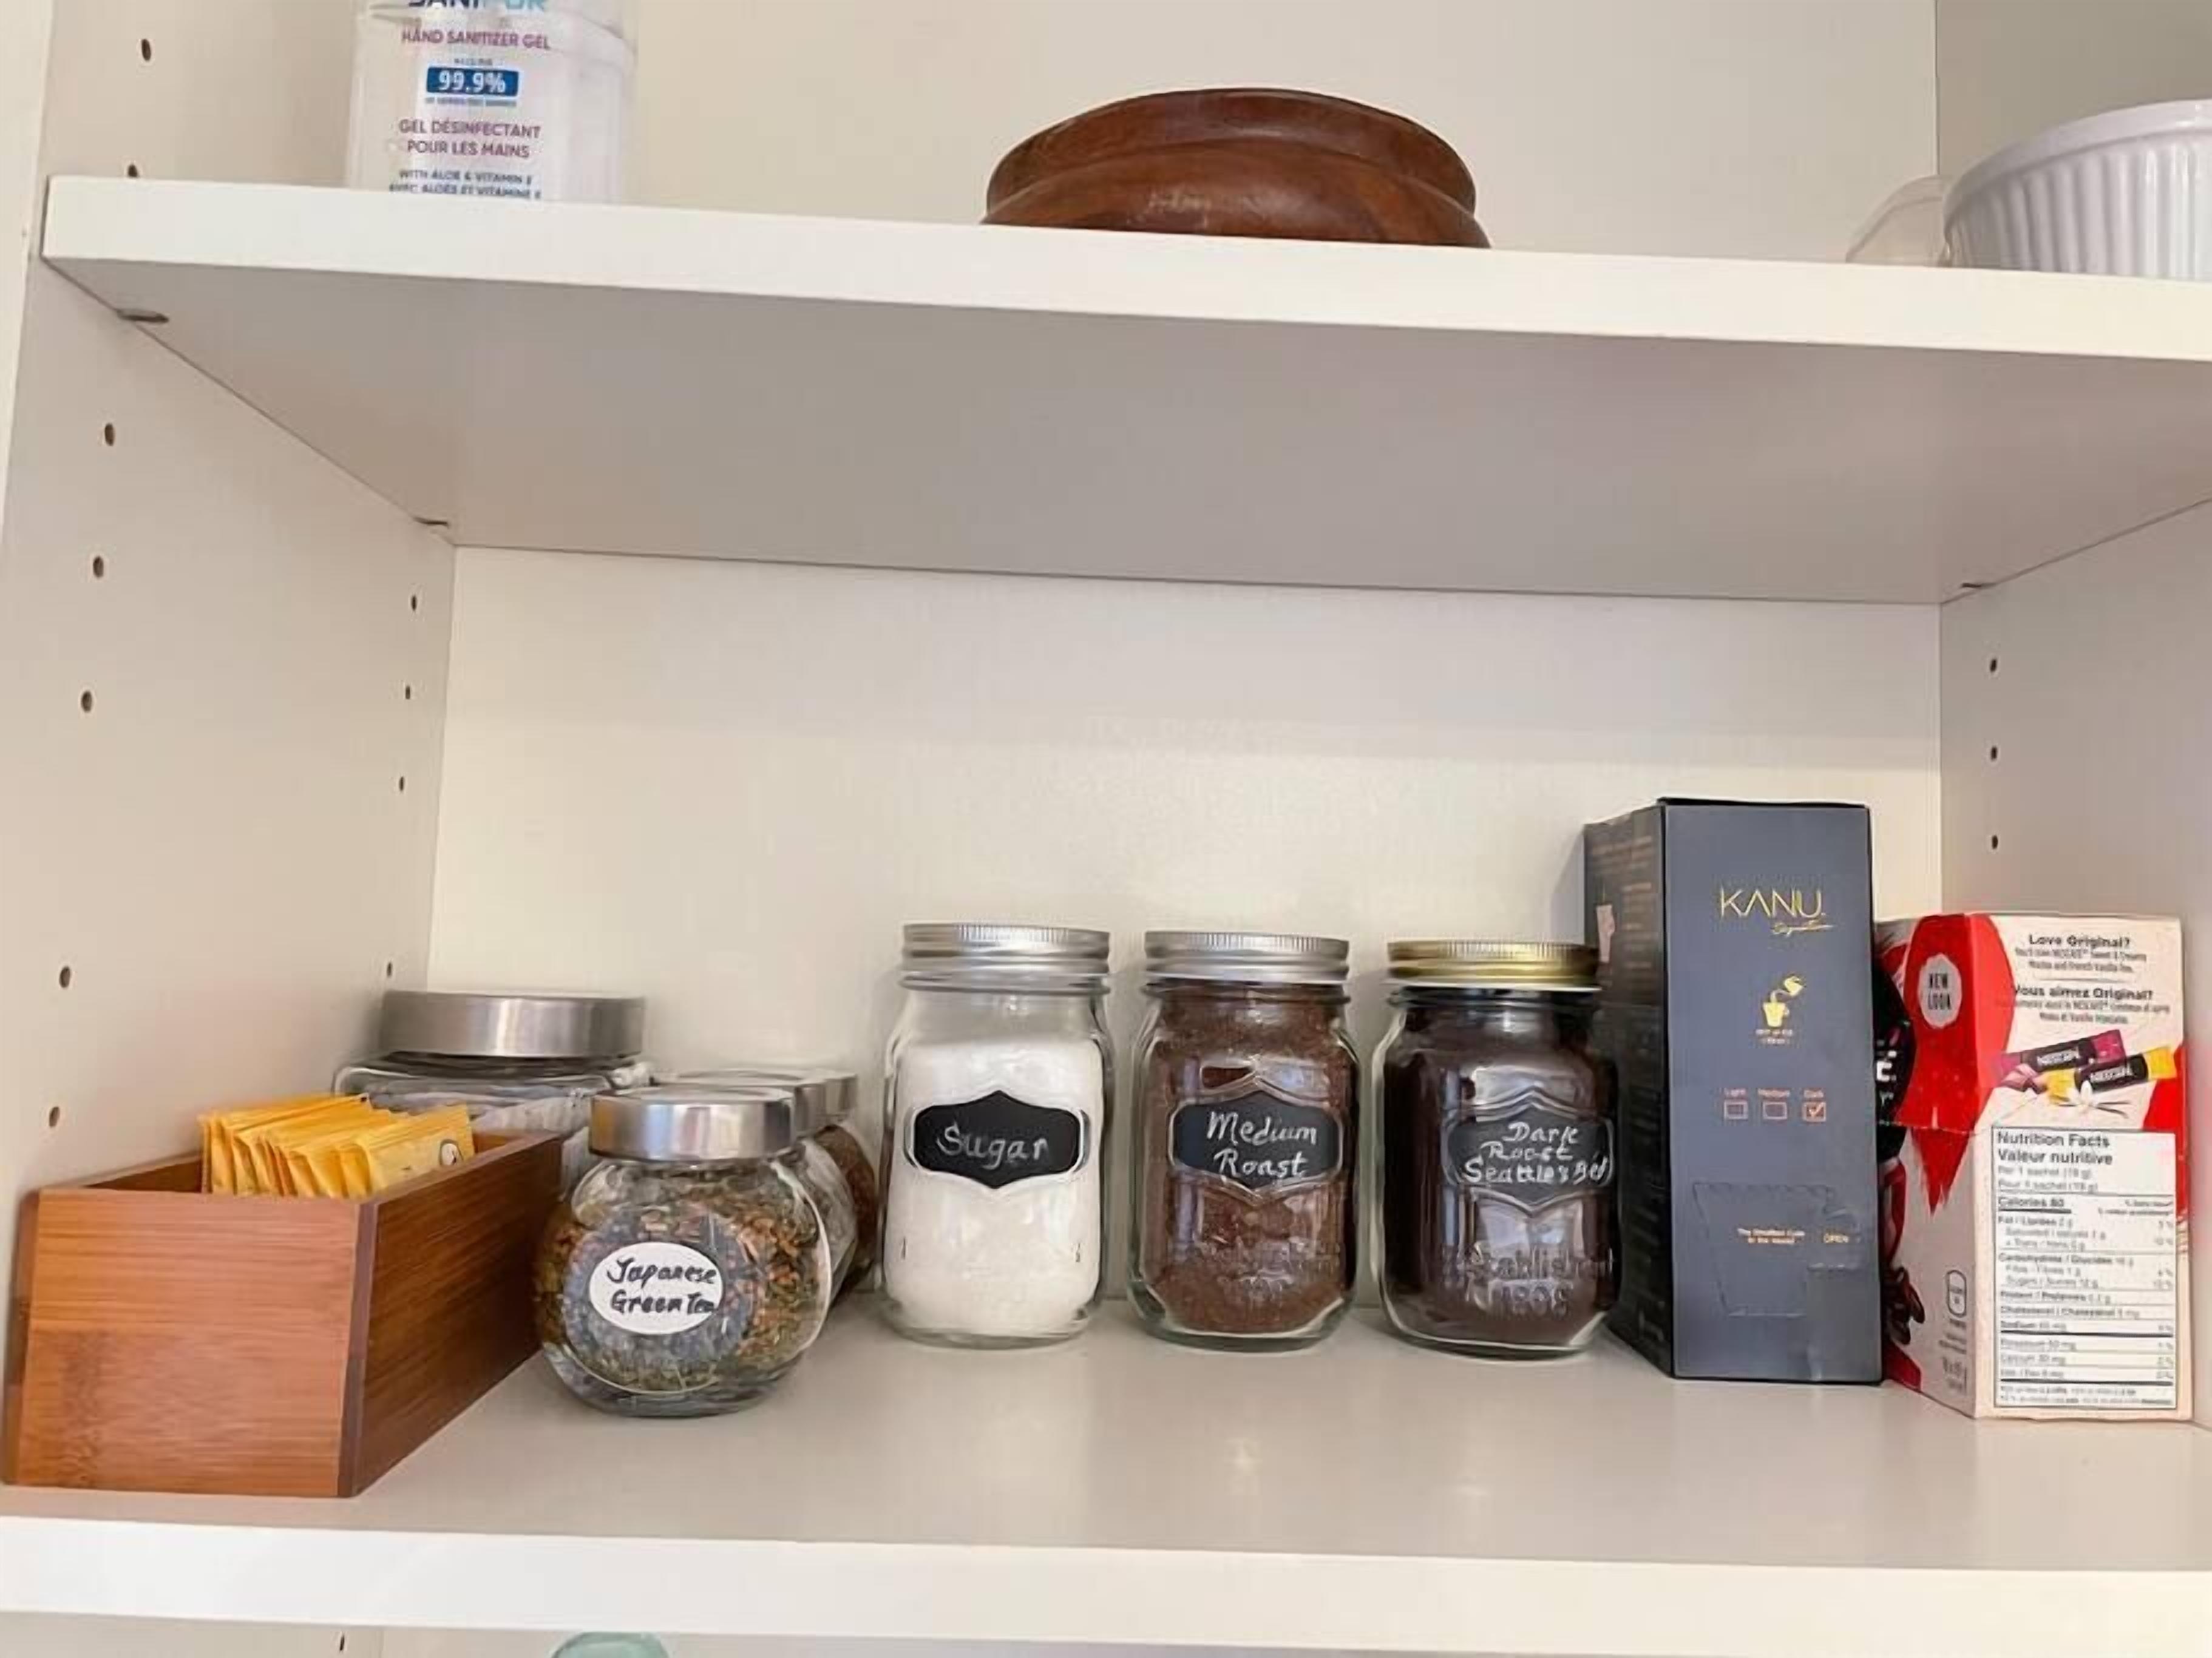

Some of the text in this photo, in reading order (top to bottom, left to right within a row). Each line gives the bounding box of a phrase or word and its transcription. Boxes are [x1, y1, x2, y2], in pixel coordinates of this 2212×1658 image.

[401, 28, 551, 50] HAND SANITIZER GEL
[438, 70, 506, 93] 99.9%
[398, 118, 541, 138] GEL DÉSINFECTANT
[407, 140, 530, 158] POUR LES MAINS
[399, 169, 427, 179] WITH
[475, 172, 522, 183] VITAMIN
[1720, 887, 1822, 918] KANU
[2029, 934, 2130, 949] Love Original?
[2094, 987, 2154, 1000] Original?
[1206, 1111, 1317, 1146] Medium
[1502, 1122, 1579, 1145] Dark
[1998, 1131, 2111, 1148] Nutrition Facts
[935, 1120, 1050, 1170] Sugar
[1213, 1147, 1309, 1179] Roast
[1998, 1149, 2113, 1165] Valeur nutritive
[607, 1257, 717, 1289] Japanese
[611, 1289, 683, 1315] Green
